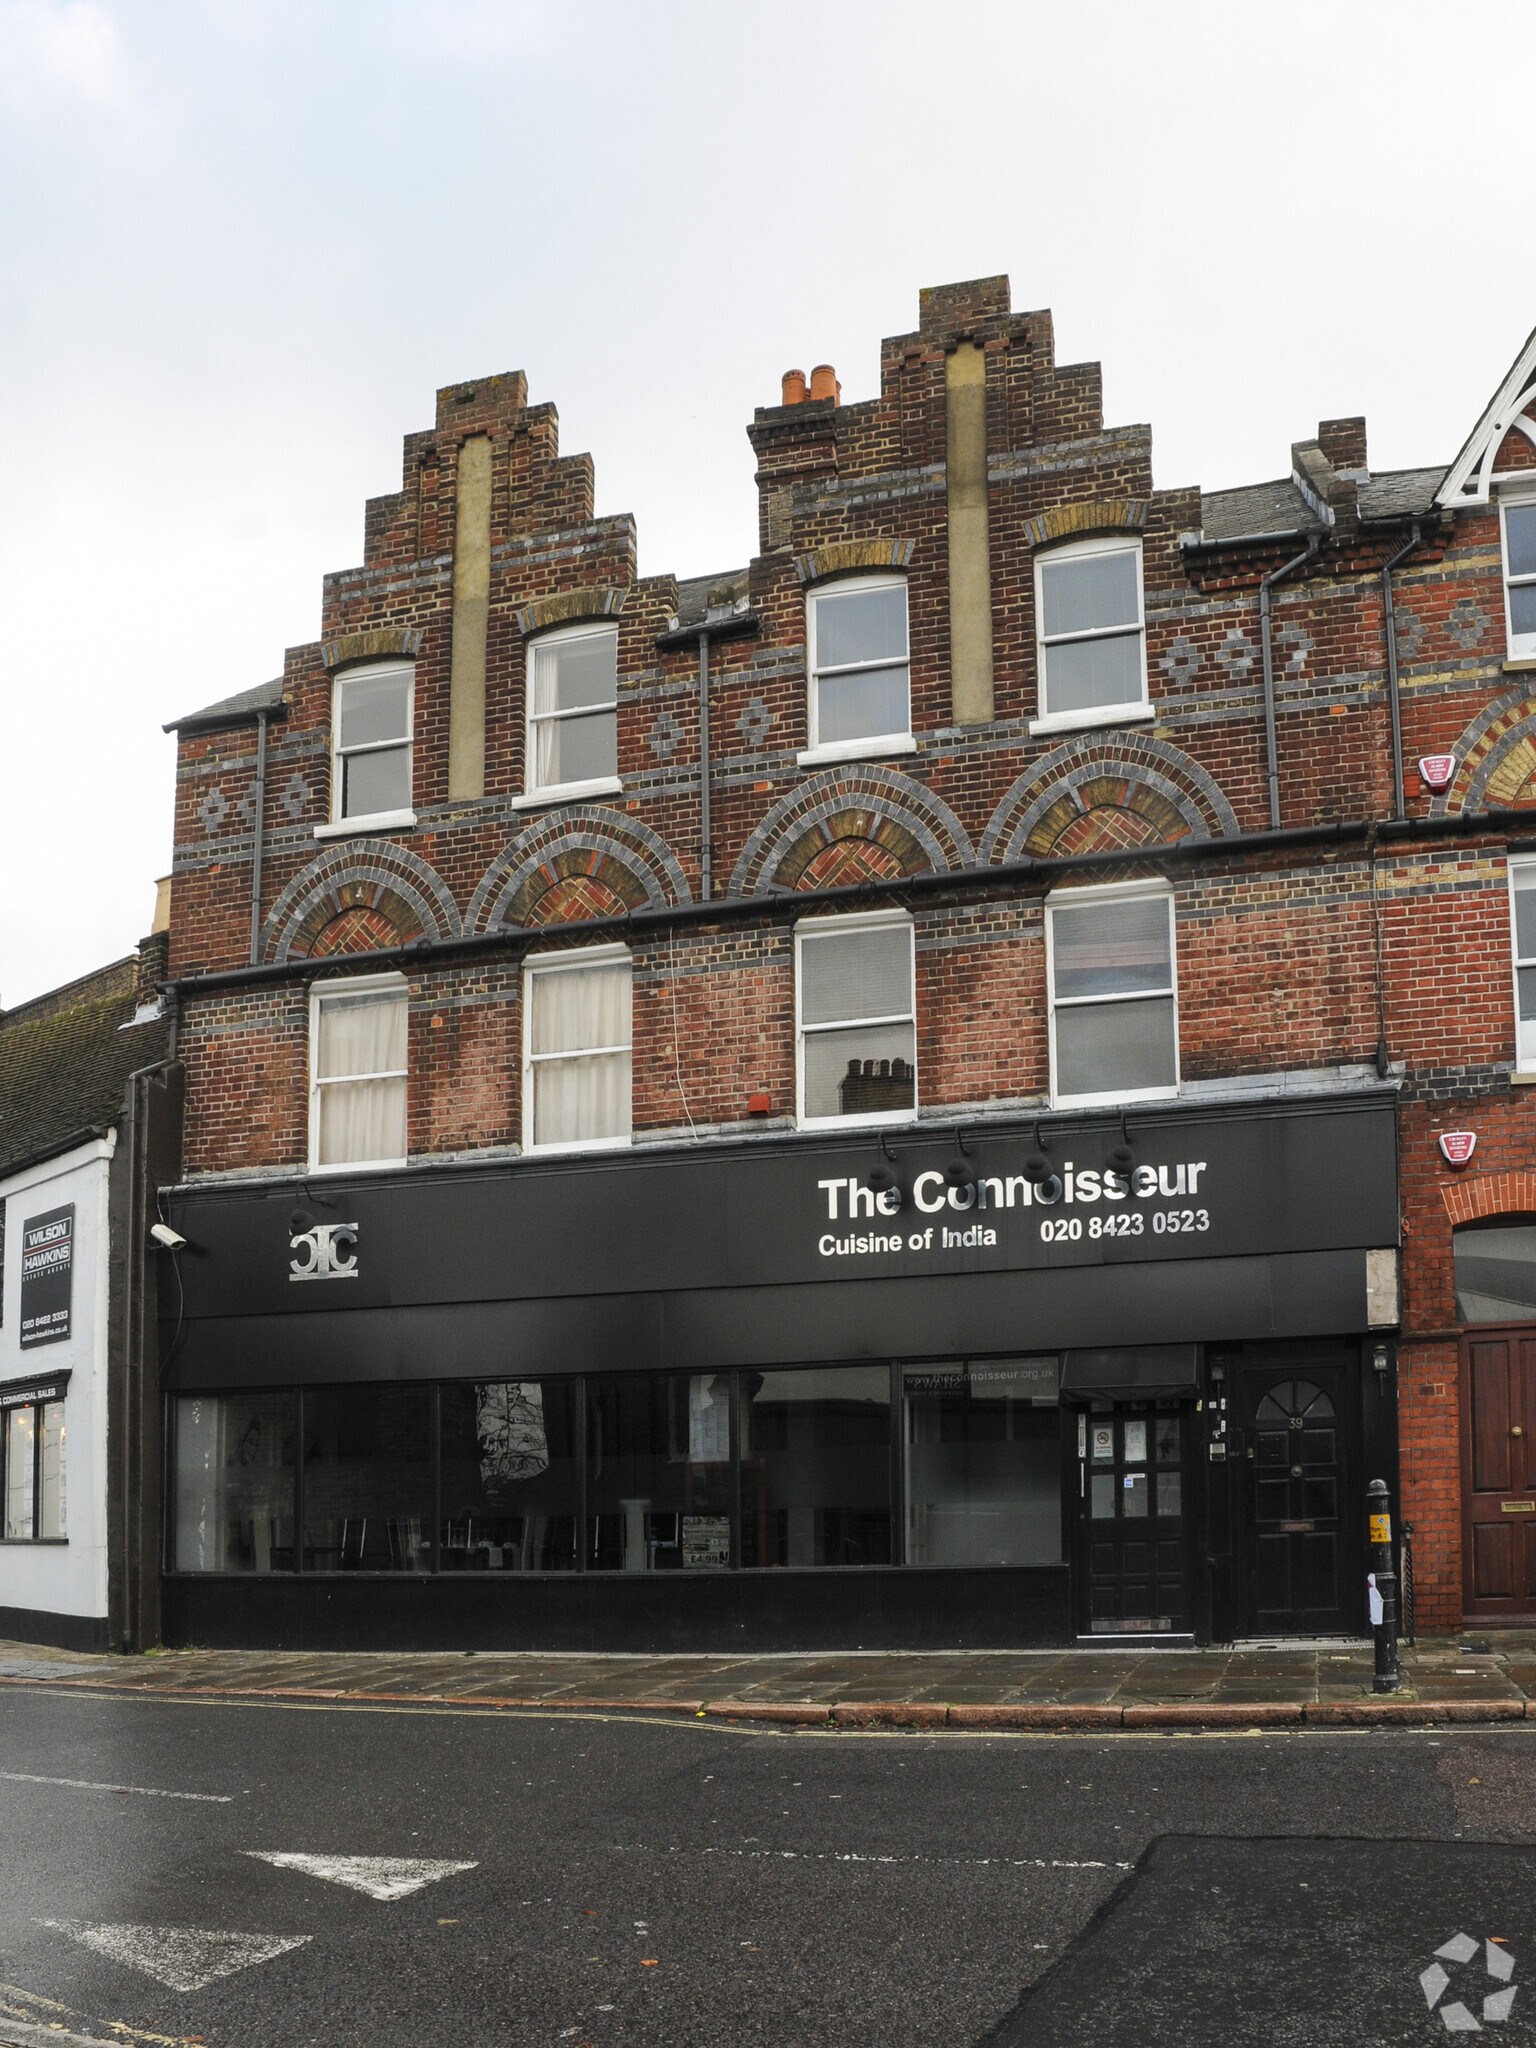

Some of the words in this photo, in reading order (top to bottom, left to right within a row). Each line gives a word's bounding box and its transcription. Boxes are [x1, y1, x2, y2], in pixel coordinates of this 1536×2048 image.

[818, 1175, 901, 1219] The
[913, 1161, 1207, 1213] Connoisseur
[28, 1222, 66, 1246] WILSON
[1040, 1218, 1082, 1243] 020
[1088, 1214, 1144, 1239] 8423
[1152, 1209, 1210, 1234] 0523
[818, 1232, 902, 1256] Cuisine
[908, 1228, 933, 1249] of
[941, 1225, 997, 1248] India
[24, 1245, 69, 1272] HAWKINS
[22, 1318, 34, 1330] 020
[52, 1310, 68, 1323] 3333
[905, 1368, 1055, 1384] www.theconnoisseur.org.uk
[3, 1392, 37, 1405] COMMERCIAL
[38, 1388, 56, 1398] SALES
[1288, 1417, 1303, 1429] 39
[691, 1555, 718, 1564] £4.99
